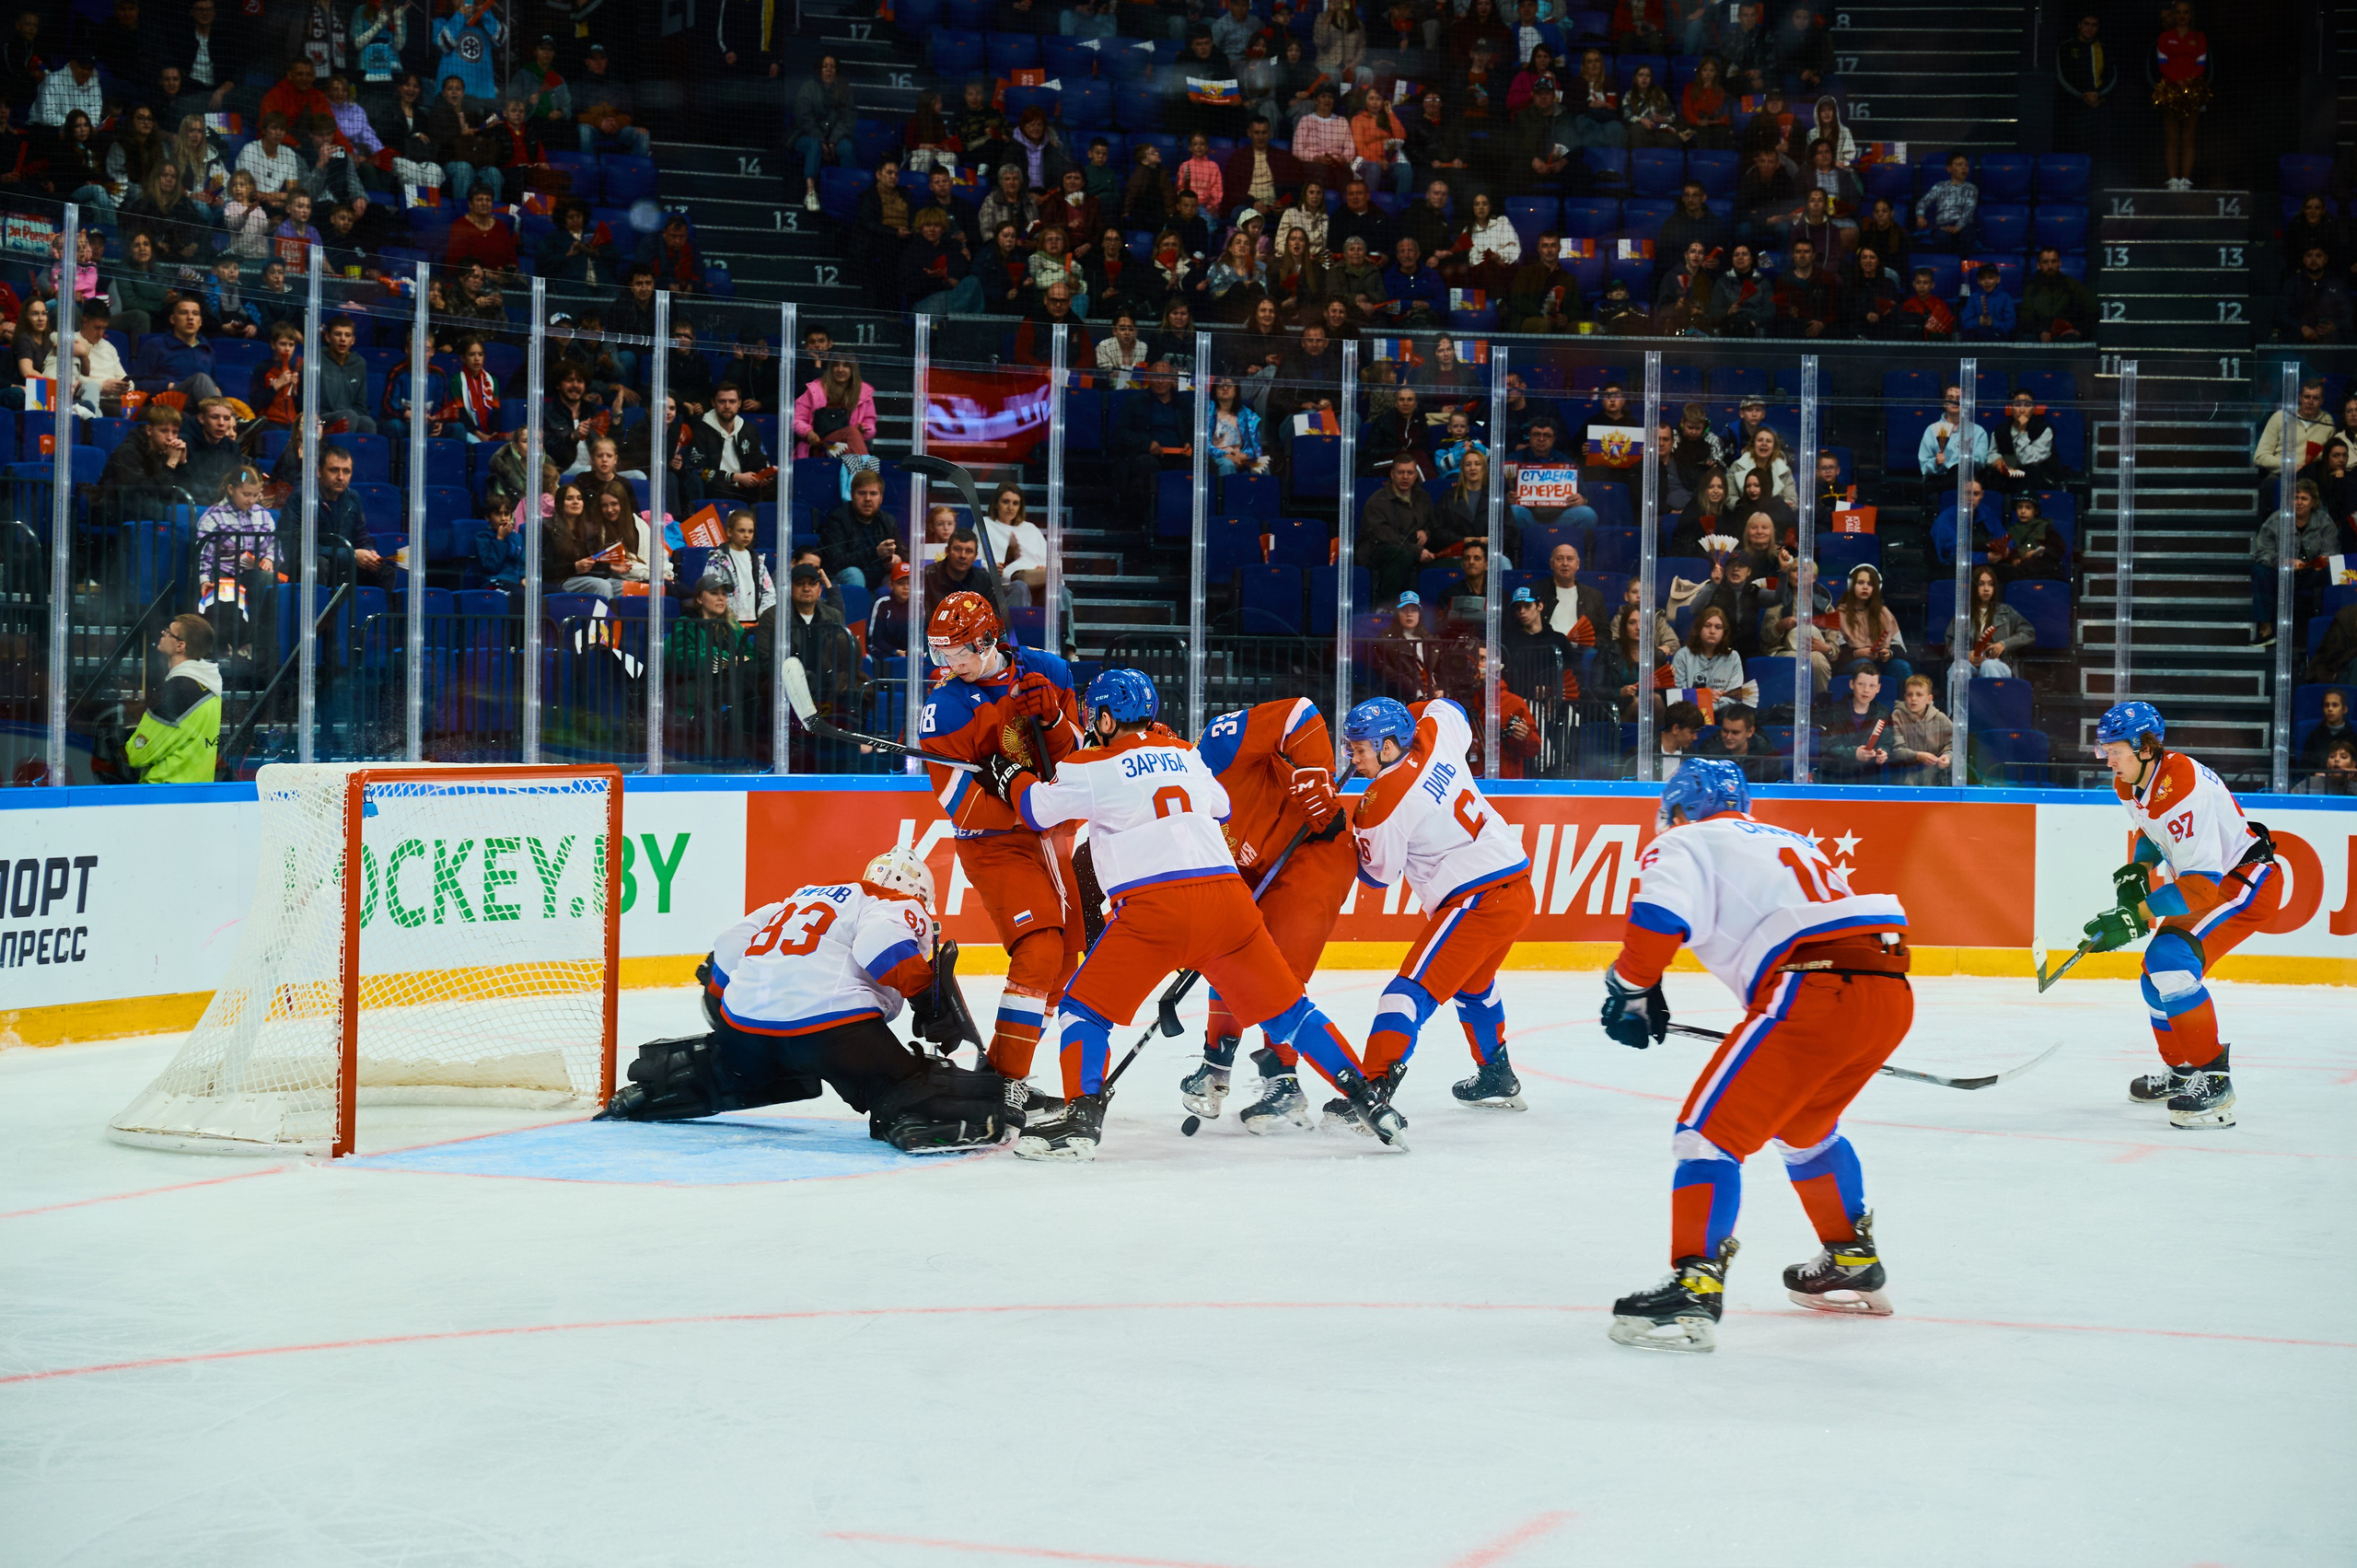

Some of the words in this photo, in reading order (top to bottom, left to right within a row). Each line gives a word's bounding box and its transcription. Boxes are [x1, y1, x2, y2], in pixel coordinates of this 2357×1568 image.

[849, 24, 872, 41] 17
[1836, 57, 1859, 73] 17
[888, 73, 913, 88] 16
[1848, 102, 1870, 119] 16
[737, 157, 762, 177] 14
[2110, 197, 2135, 217] 14
[2216, 197, 2242, 217] 14
[772, 211, 798, 230] 13
[2104, 247, 2130, 267] 13
[2218, 247, 2244, 267] 13
[814, 265, 840, 285] 12
[2100, 302, 2127, 321] 12
[2217, 302, 2243, 322] 12
[855, 324, 875, 344] 11
[2100, 355, 2121, 375] 11
[2219, 357, 2241, 378] 11
[1380, 726, 1396, 734] CCM
[1121, 752, 1189, 779] ЗАРУБА
[1422, 761, 1457, 805] ДИЛЬ
[2166, 810, 2195, 844] 97
[744, 900, 839, 958] 83
